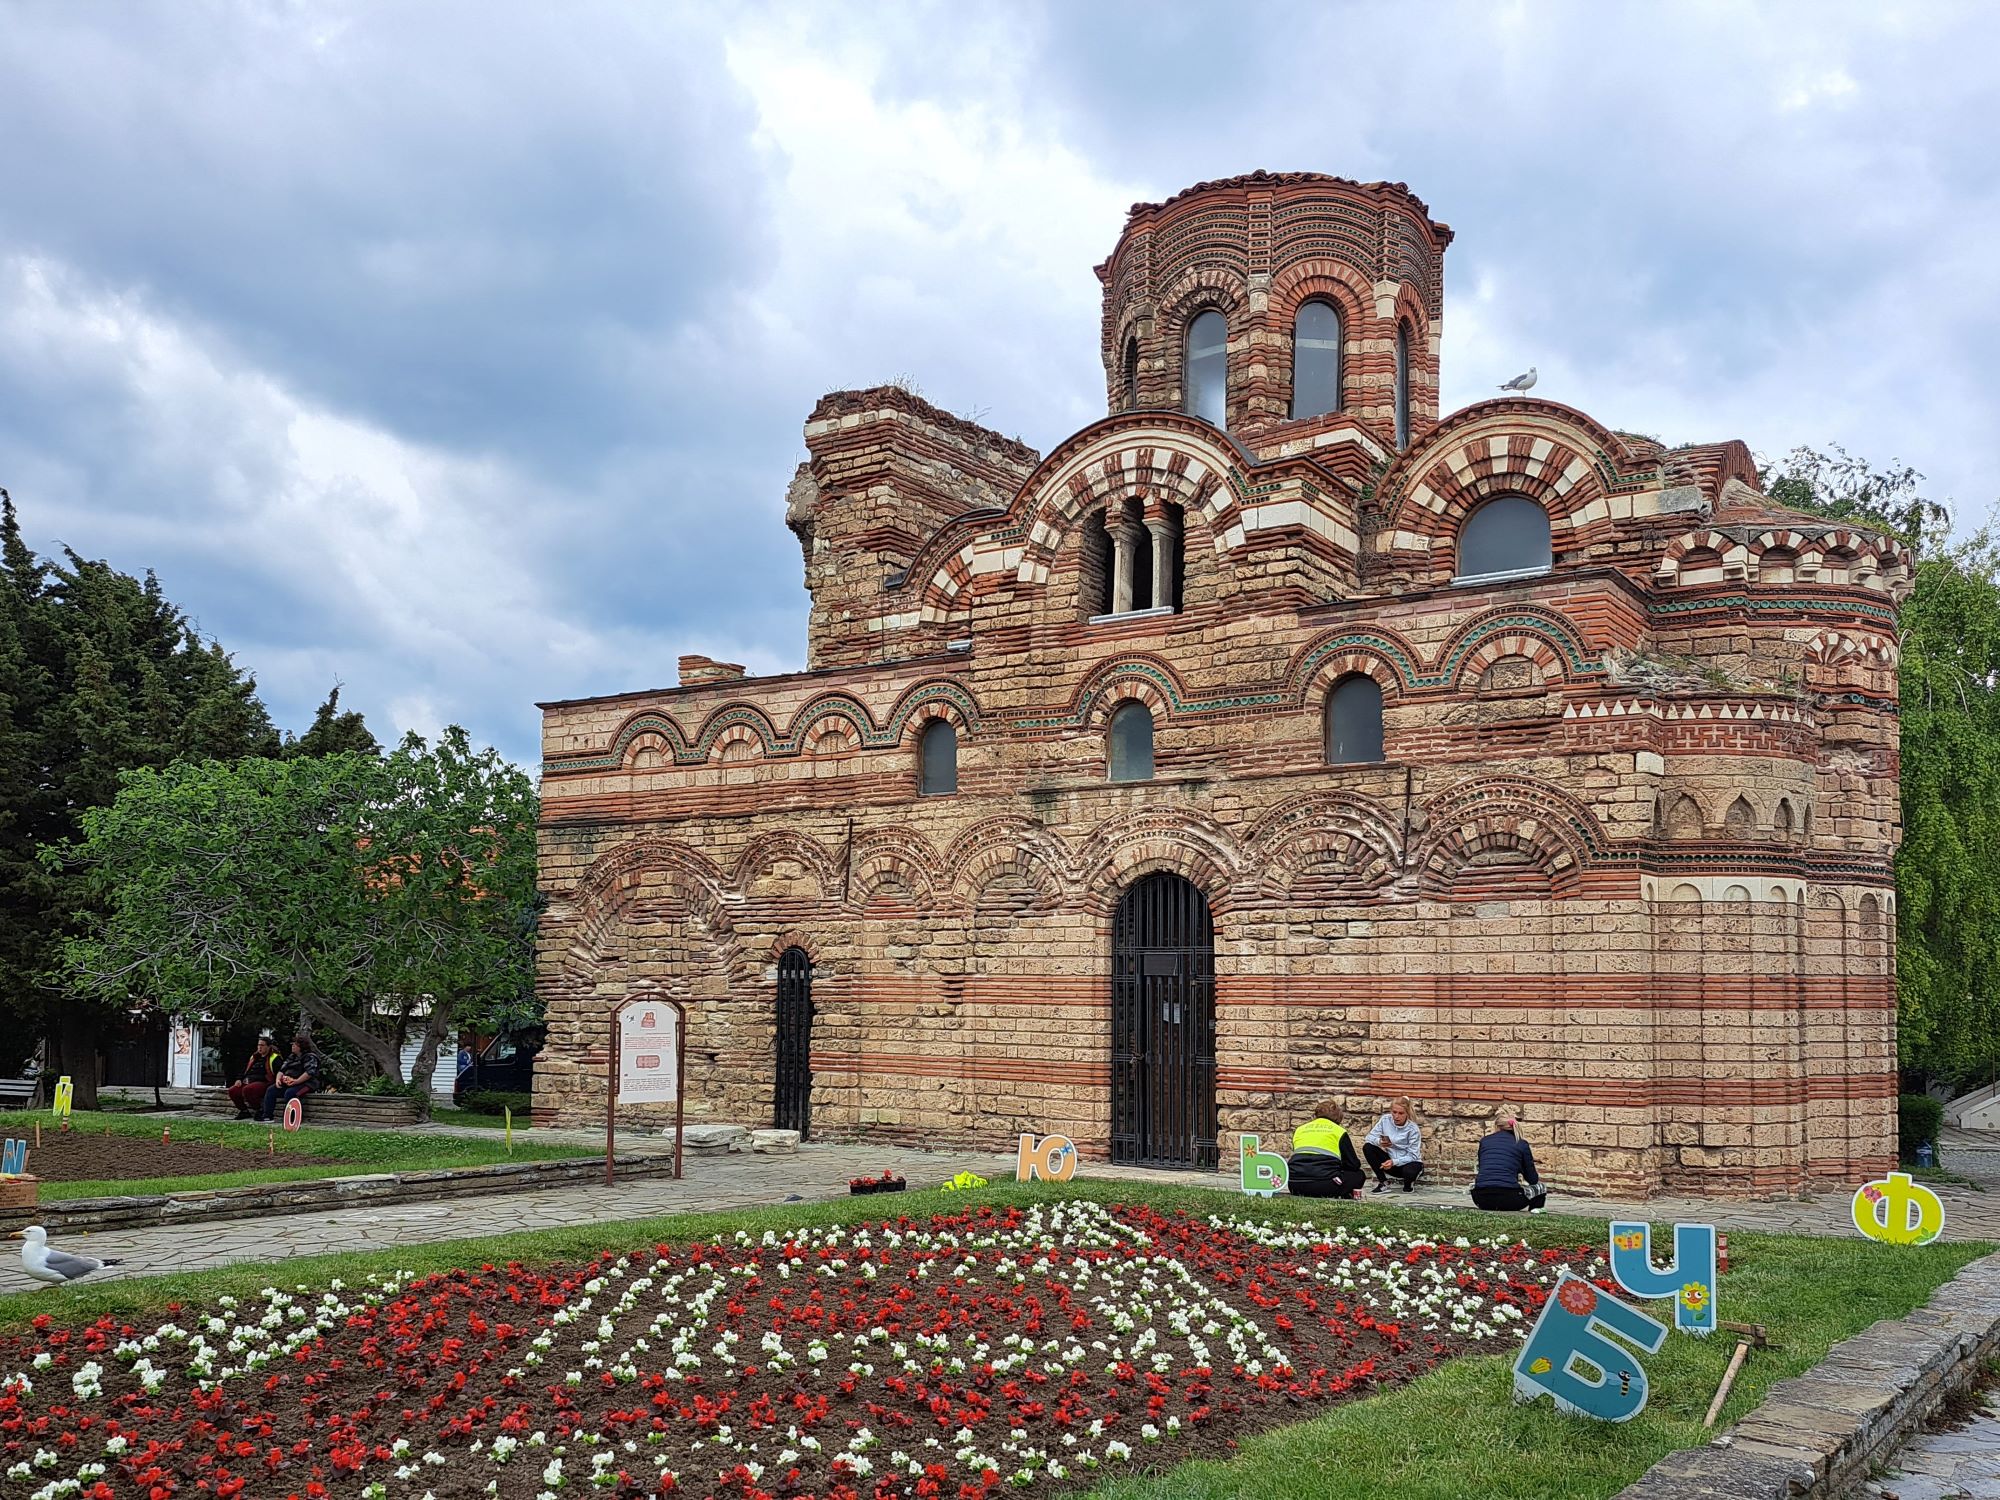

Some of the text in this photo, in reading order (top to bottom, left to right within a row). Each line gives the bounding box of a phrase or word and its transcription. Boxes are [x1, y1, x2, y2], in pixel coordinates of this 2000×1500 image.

[1016, 1134, 1077, 1183] Ю
[1851, 1172, 1945, 1246] Ф
[1610, 1221, 1717, 1333] Ч
[1513, 1271, 1669, 1423] Б
